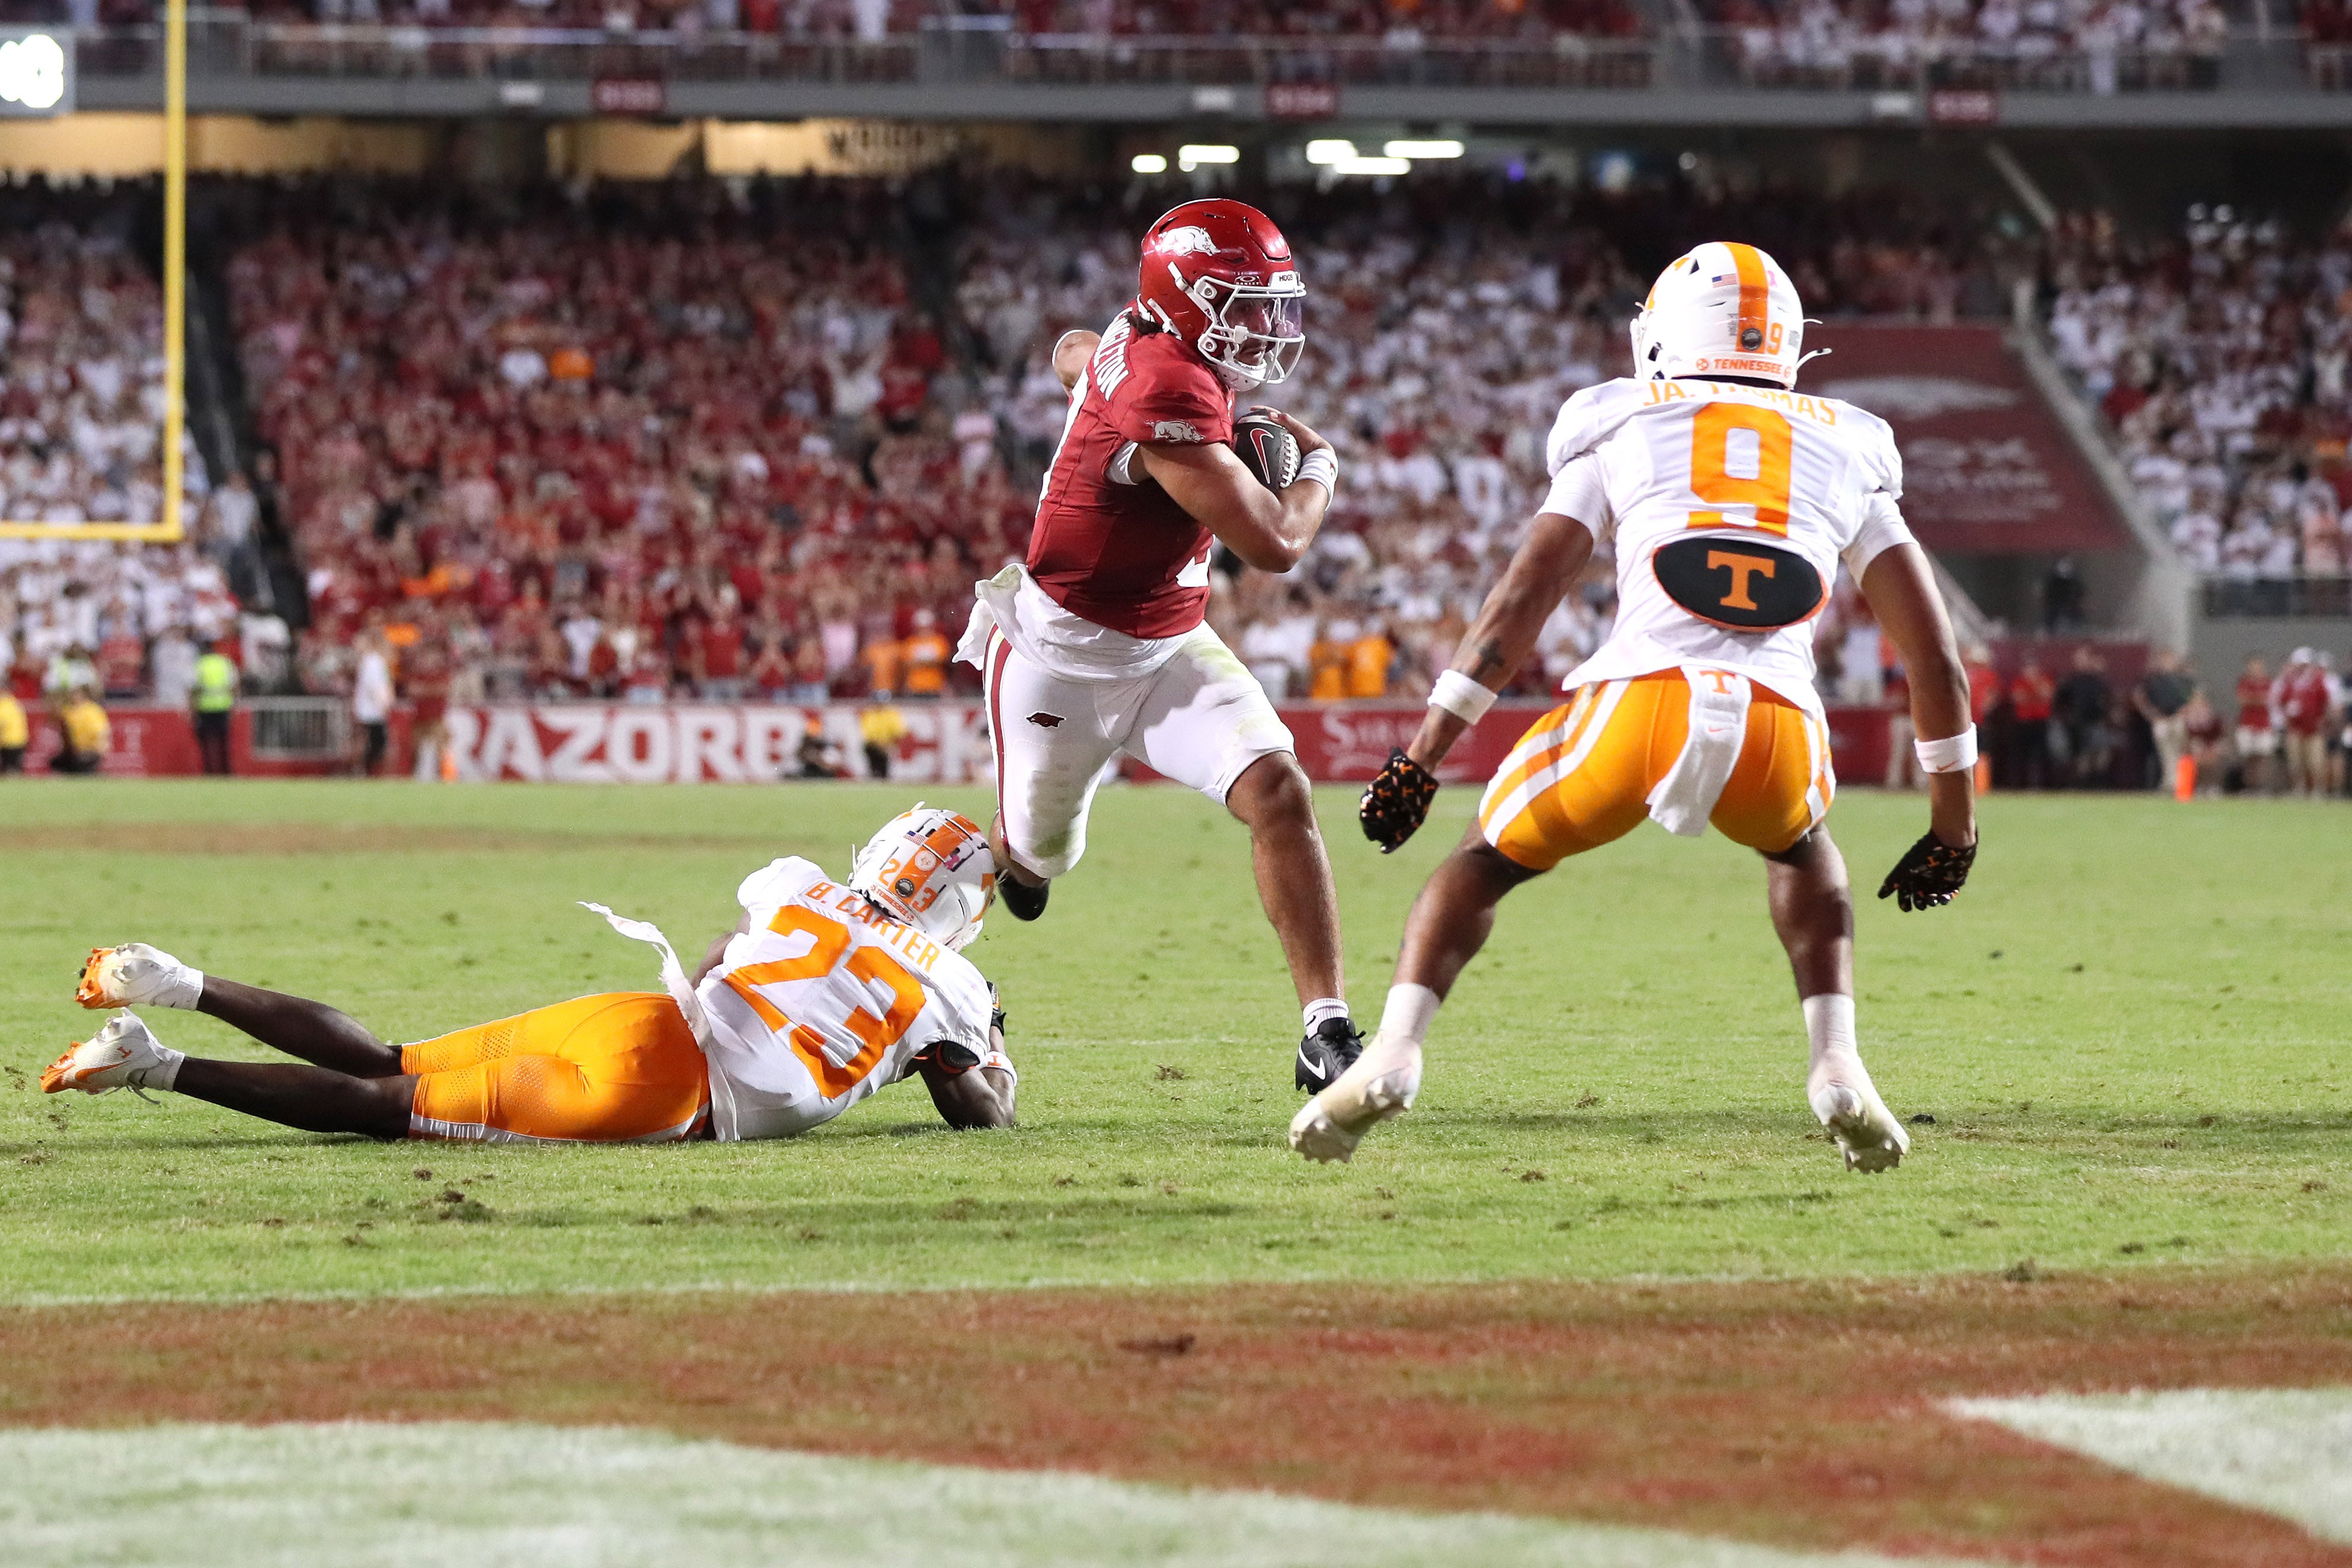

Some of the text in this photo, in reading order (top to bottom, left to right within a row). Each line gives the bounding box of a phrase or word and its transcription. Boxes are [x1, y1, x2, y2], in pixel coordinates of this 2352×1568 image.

[1767, 323, 1783, 355] 9
[1714, 358, 1782, 374] TENNESSEE
[1643, 382, 1696, 406] JA.
[1687, 402, 1792, 538] 9
[1707, 550, 1776, 611] T
[1700, 670, 1737, 694] T
[806, 882, 941, 973] B. CARTER
[724, 905, 926, 1099] 23
